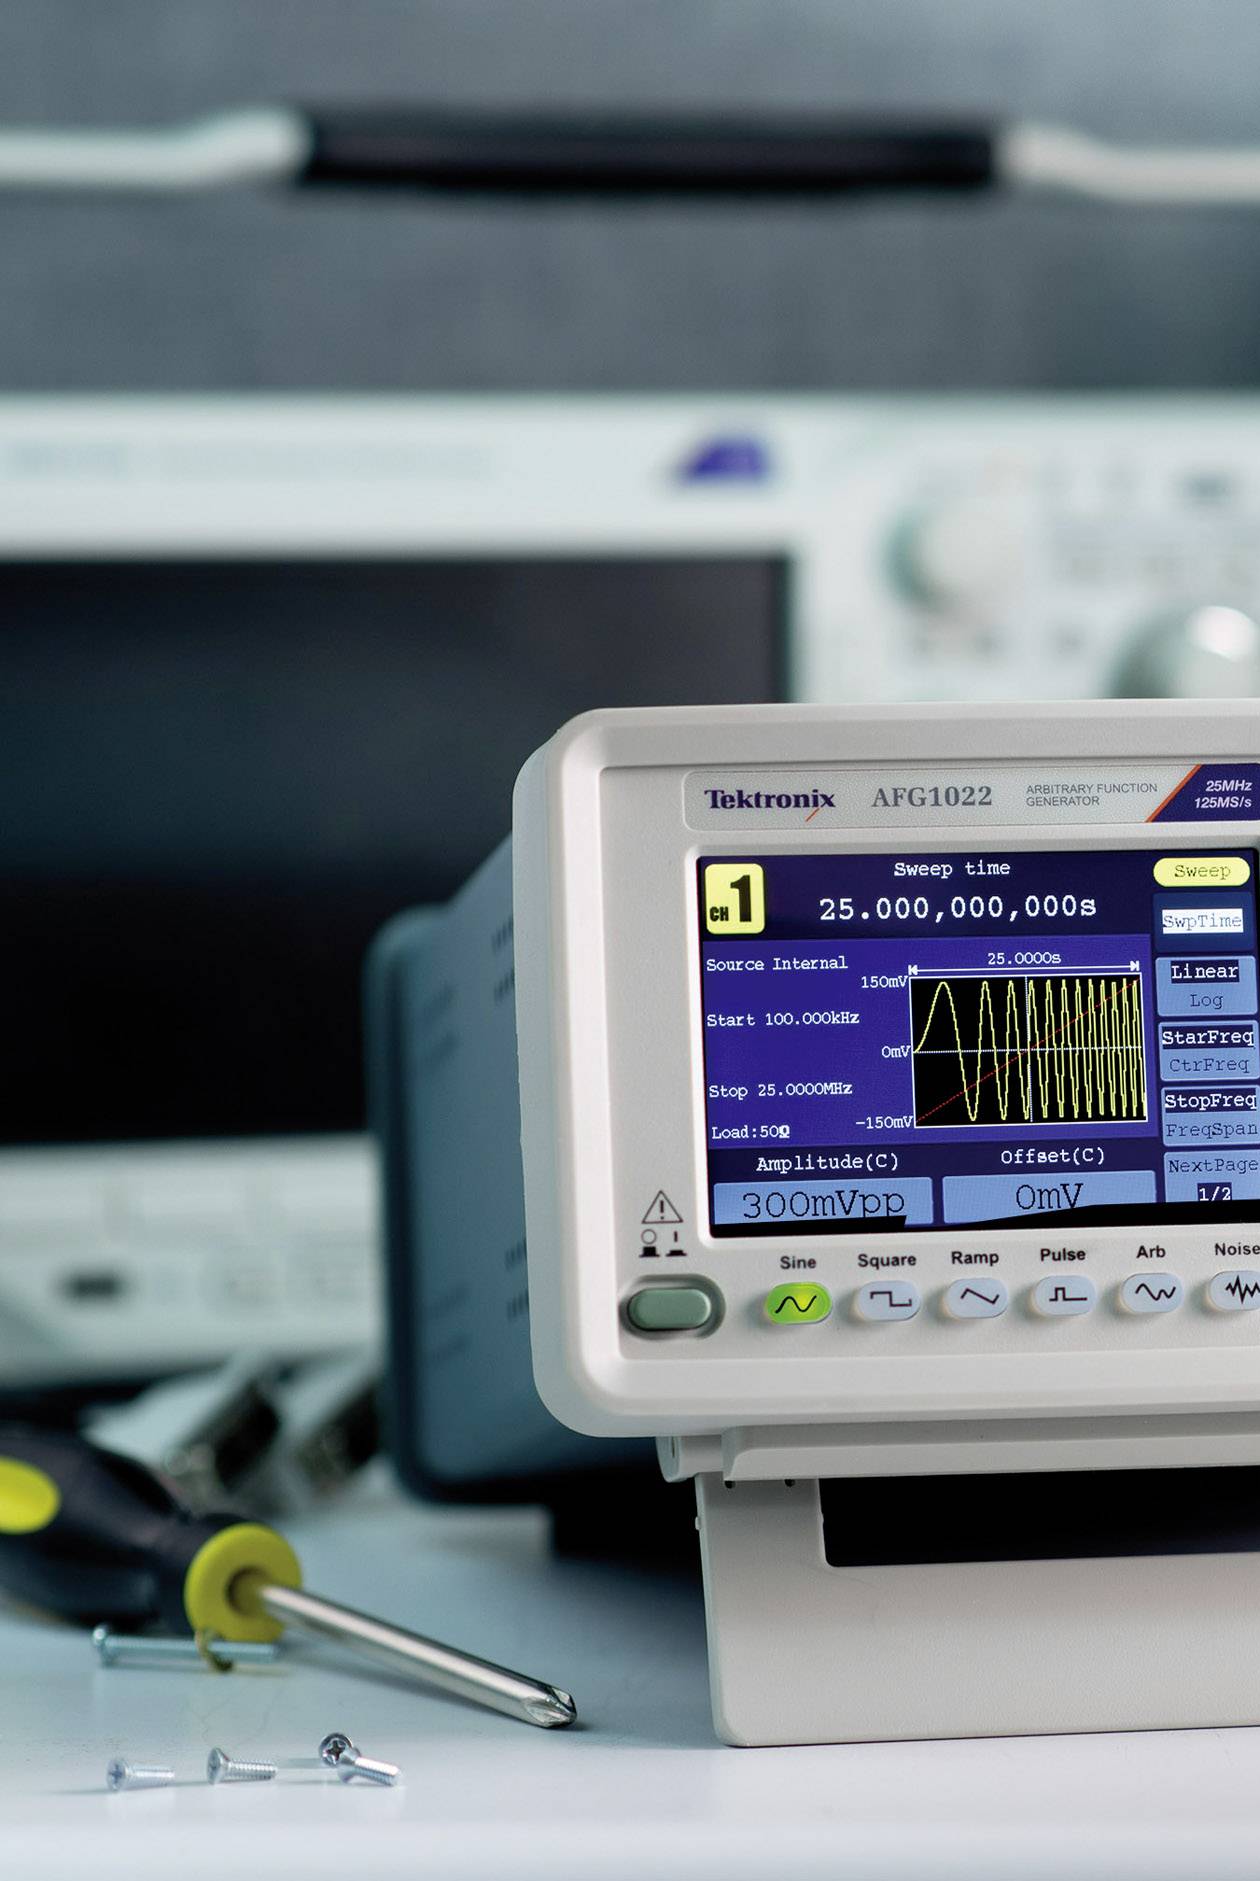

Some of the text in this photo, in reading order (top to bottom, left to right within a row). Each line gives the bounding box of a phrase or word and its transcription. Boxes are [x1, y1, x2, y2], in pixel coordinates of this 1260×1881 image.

[1026, 782, 1158, 794] ARBITRARY FUNCTION
[1205, 780, 1253, 792] 25MHz
[704, 788, 836, 809] Tektronix
[871, 786, 993, 807] AFG1022
[1026, 796, 1100, 806] GENERATOR
[1195, 796, 1252, 808] 125MS/s
[894, 860, 1011, 878] Sweep time
[1174, 864, 1231, 880] Sweep
[709, 874, 753, 922] CH 1
[819, 894, 1097, 922] 25.000,000,000s
[1163, 914, 1243, 930] SwpTime
[706, 955, 848, 971] Source Internal
[987, 951, 1062, 965] 25.0000s
[1171, 962, 1238, 980] Linear
[860, 976, 908, 988] 150mV
[1189, 992, 1224, 1009] Log
[706, 1011, 860, 1026] Start 100.000kHz
[1162, 1029, 1254, 1047] StarFreq
[881, 1045, 910, 1057] 0mV
[1169, 1057, 1250, 1074] CtrFreq
[709, 1082, 853, 1100] Stop 25.0000MHz
[1164, 1092, 1258, 1111] StopFreq
[855, 1116, 914, 1129] -150mV
[1166, 1122, 1258, 1139] FreqSpan
[711, 1125, 790, 1139] Load:50Ω
[755, 1152, 899, 1173] Amplitude(C)
[1000, 1146, 1105, 1165] Offset(C)
[1168, 1157, 1259, 1175] NextPage
[1016, 1183, 1084, 1209] 0mV
[1197, 1186, 1232, 1200] 1/2
[742, 1190, 905, 1219] 300mVpp
[950, 1249, 1000, 1267] Ramp
[1039, 1246, 1086, 1262] Pulse
[1136, 1244, 1166, 1259] Arb
[780, 1254, 817, 1270] Sine
[857, 1252, 917, 1270] Square
